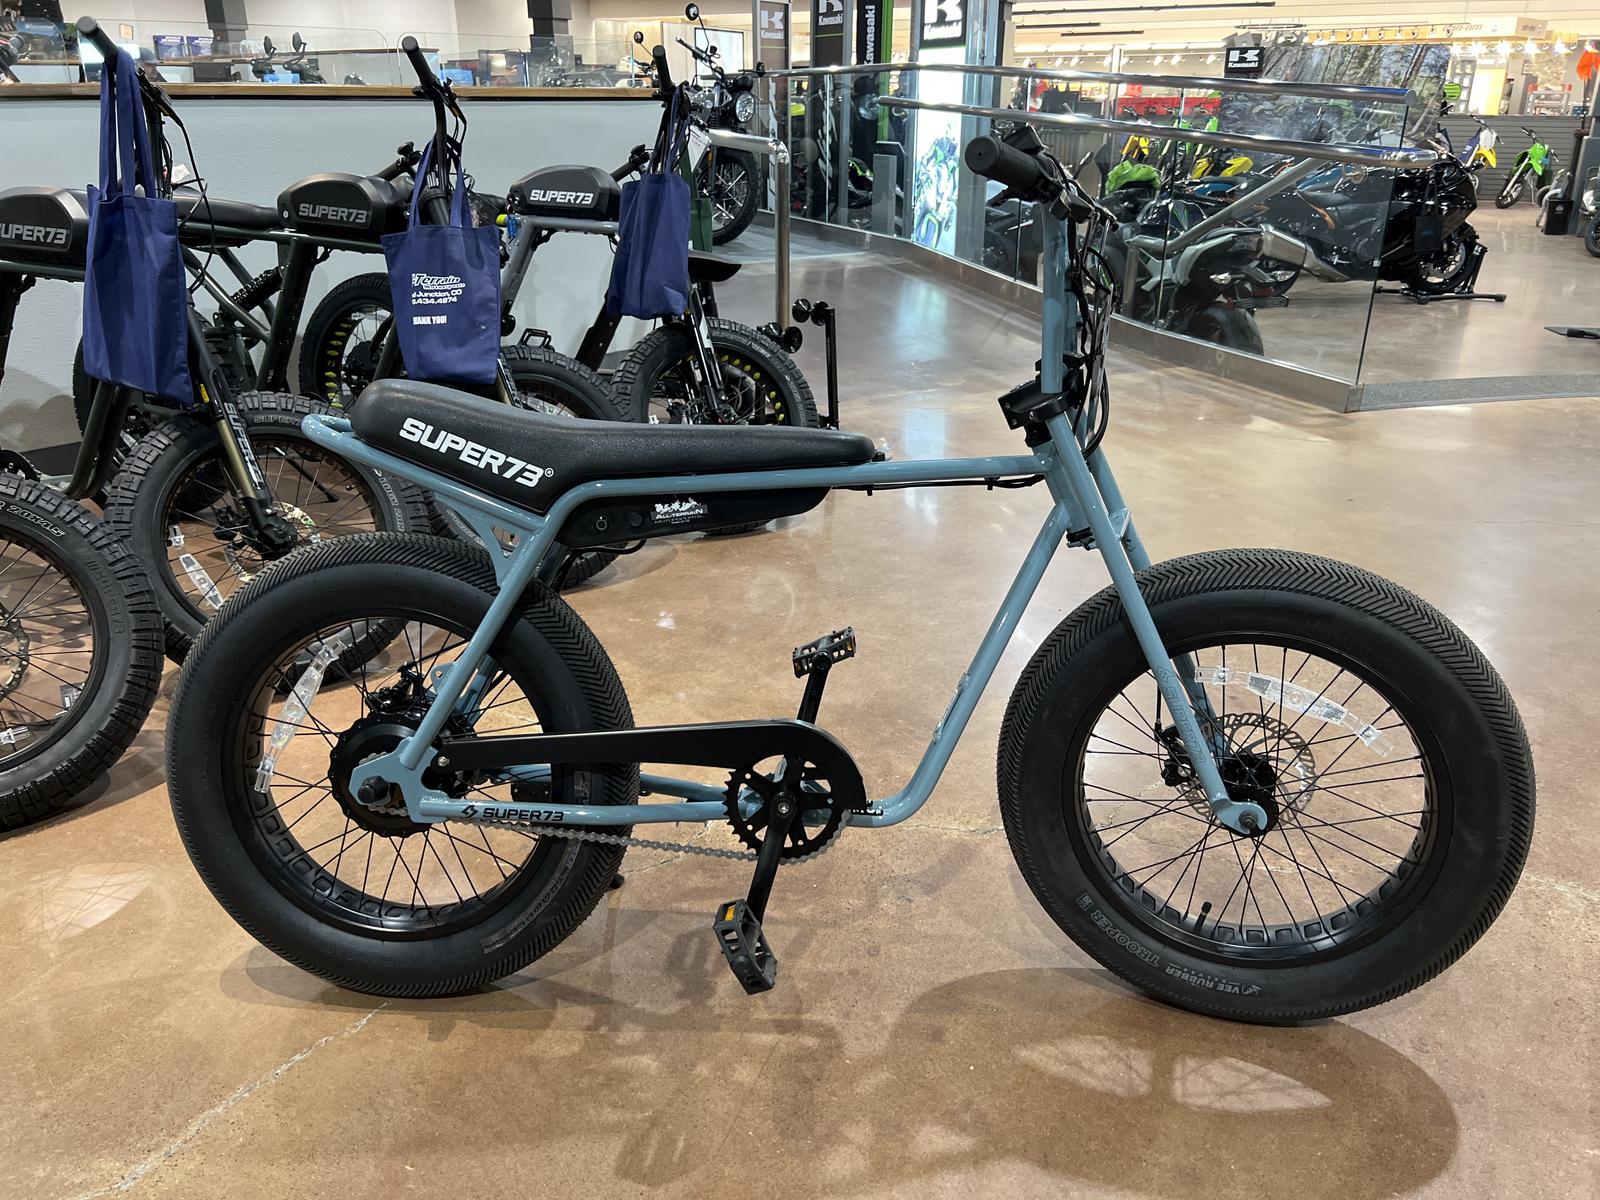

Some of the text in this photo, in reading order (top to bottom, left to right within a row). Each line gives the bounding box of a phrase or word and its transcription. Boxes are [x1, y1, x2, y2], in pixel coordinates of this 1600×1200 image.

[818, 13, 844, 26] Kawasaki
[923, 21, 962, 40] Kawasaki
[529, 189, 594, 205] SUPER73
[298, 203, 367, 223] SUPER73
[0, 223, 67, 244] UPER73
[1162, 686, 1207, 764] SUPER73
[482, 807, 565, 822] SUPER73
[1090, 909, 1160, 968] TROOPER
[1164, 965, 1240, 994] VEE RUBBER
